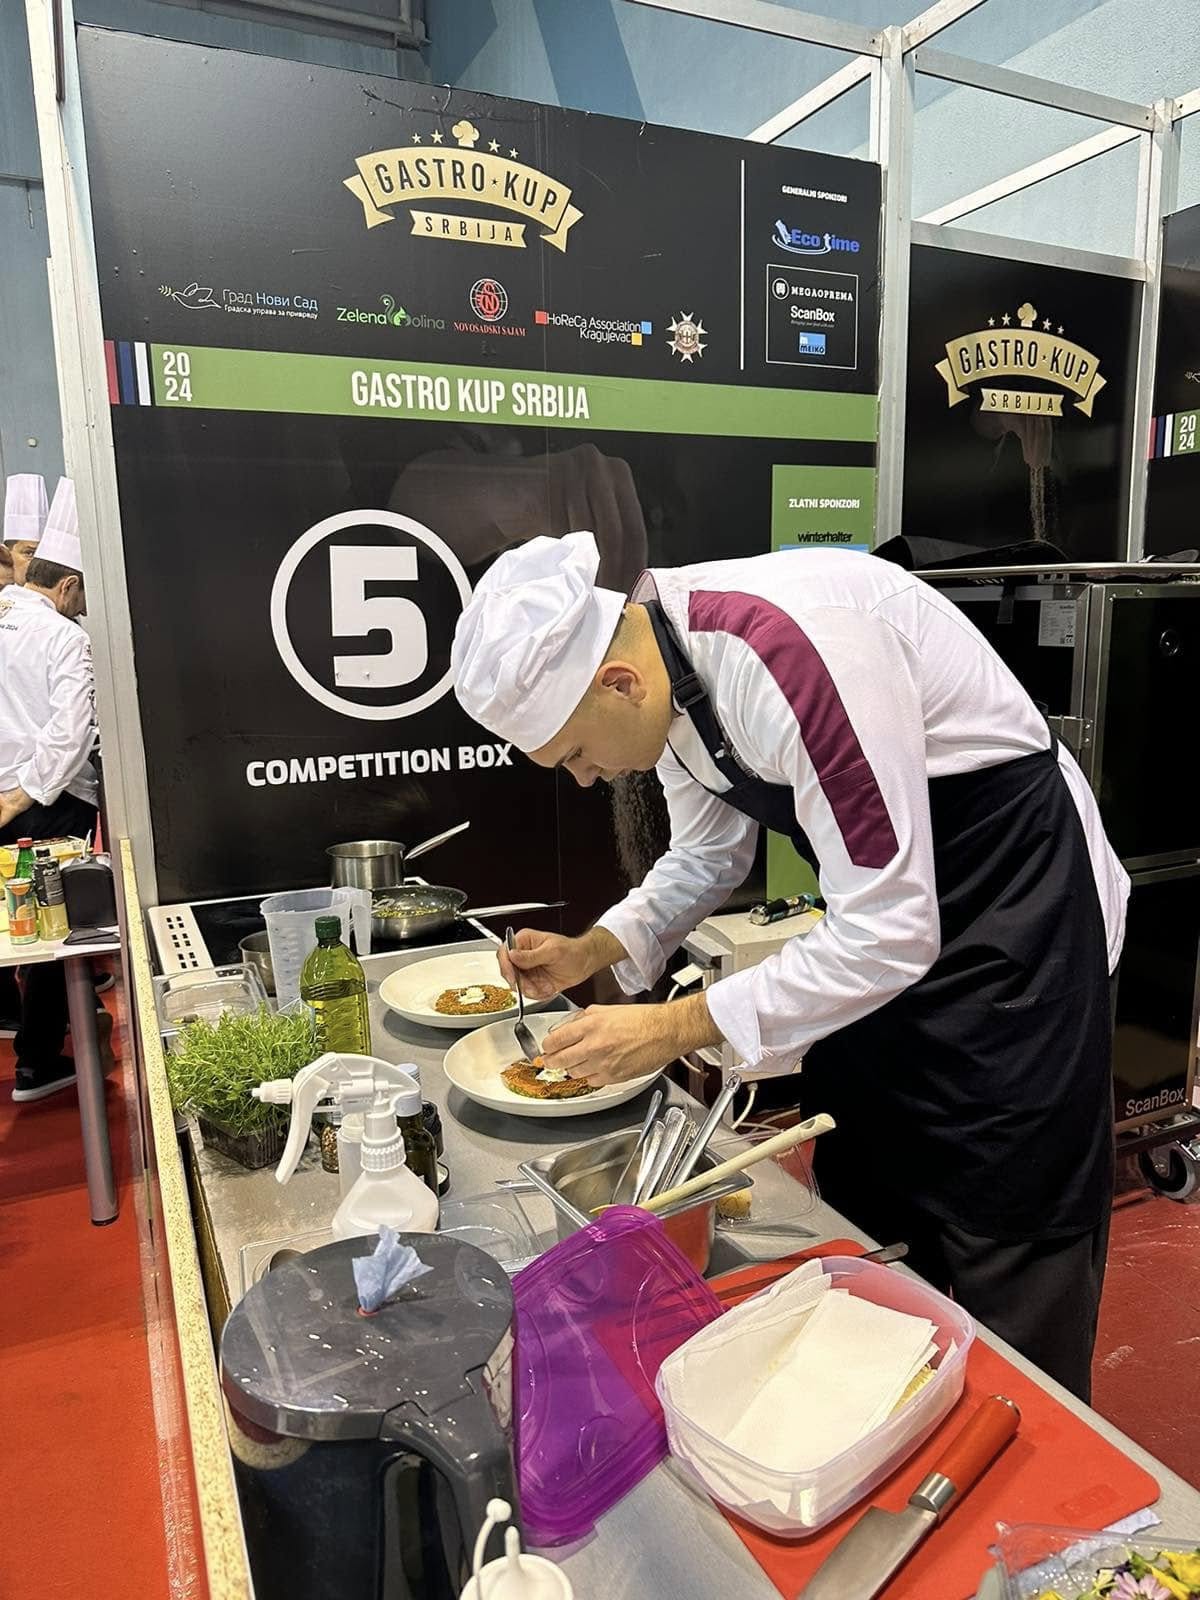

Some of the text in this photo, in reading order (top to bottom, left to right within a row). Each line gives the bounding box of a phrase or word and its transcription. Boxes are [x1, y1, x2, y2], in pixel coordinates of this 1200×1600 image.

[375, 158, 558, 214] GASTRO KUP
[817, 191, 848, 203] SPONZORI
[425, 216, 513, 242] SRBIJA
[791, 229, 820, 247] Eco
[223, 289, 319, 311] Град Нови Сад
[791, 286, 853, 302] MEGAOPREMA
[336, 307, 387, 325] Zelena
[547, 313, 641, 332] HoReCa Association
[790, 305, 835, 322] ScanBox
[453, 321, 526, 337] NOVOSADSKI SAJAM
[580, 327, 632, 344] Kragujevac
[162, 351, 191, 376] 20
[959, 339, 1089, 383] GASTRO KUP
[165, 377, 192, 402] 24
[351, 370, 590, 420] GASTRO KUP SRBIJA
[991, 392, 1054, 412] SRBIJA
[1180, 414, 1197, 434] 20
[1178, 432, 1195, 451] 24
[788, 498, 861, 509] ZLATNI SPONZORI
[797, 531, 853, 543] winterhalter
[329, 545, 428, 689] 5
[246, 743, 514, 787] COMPETITION BOX
[1125, 1087, 1185, 1117] ScanBox
